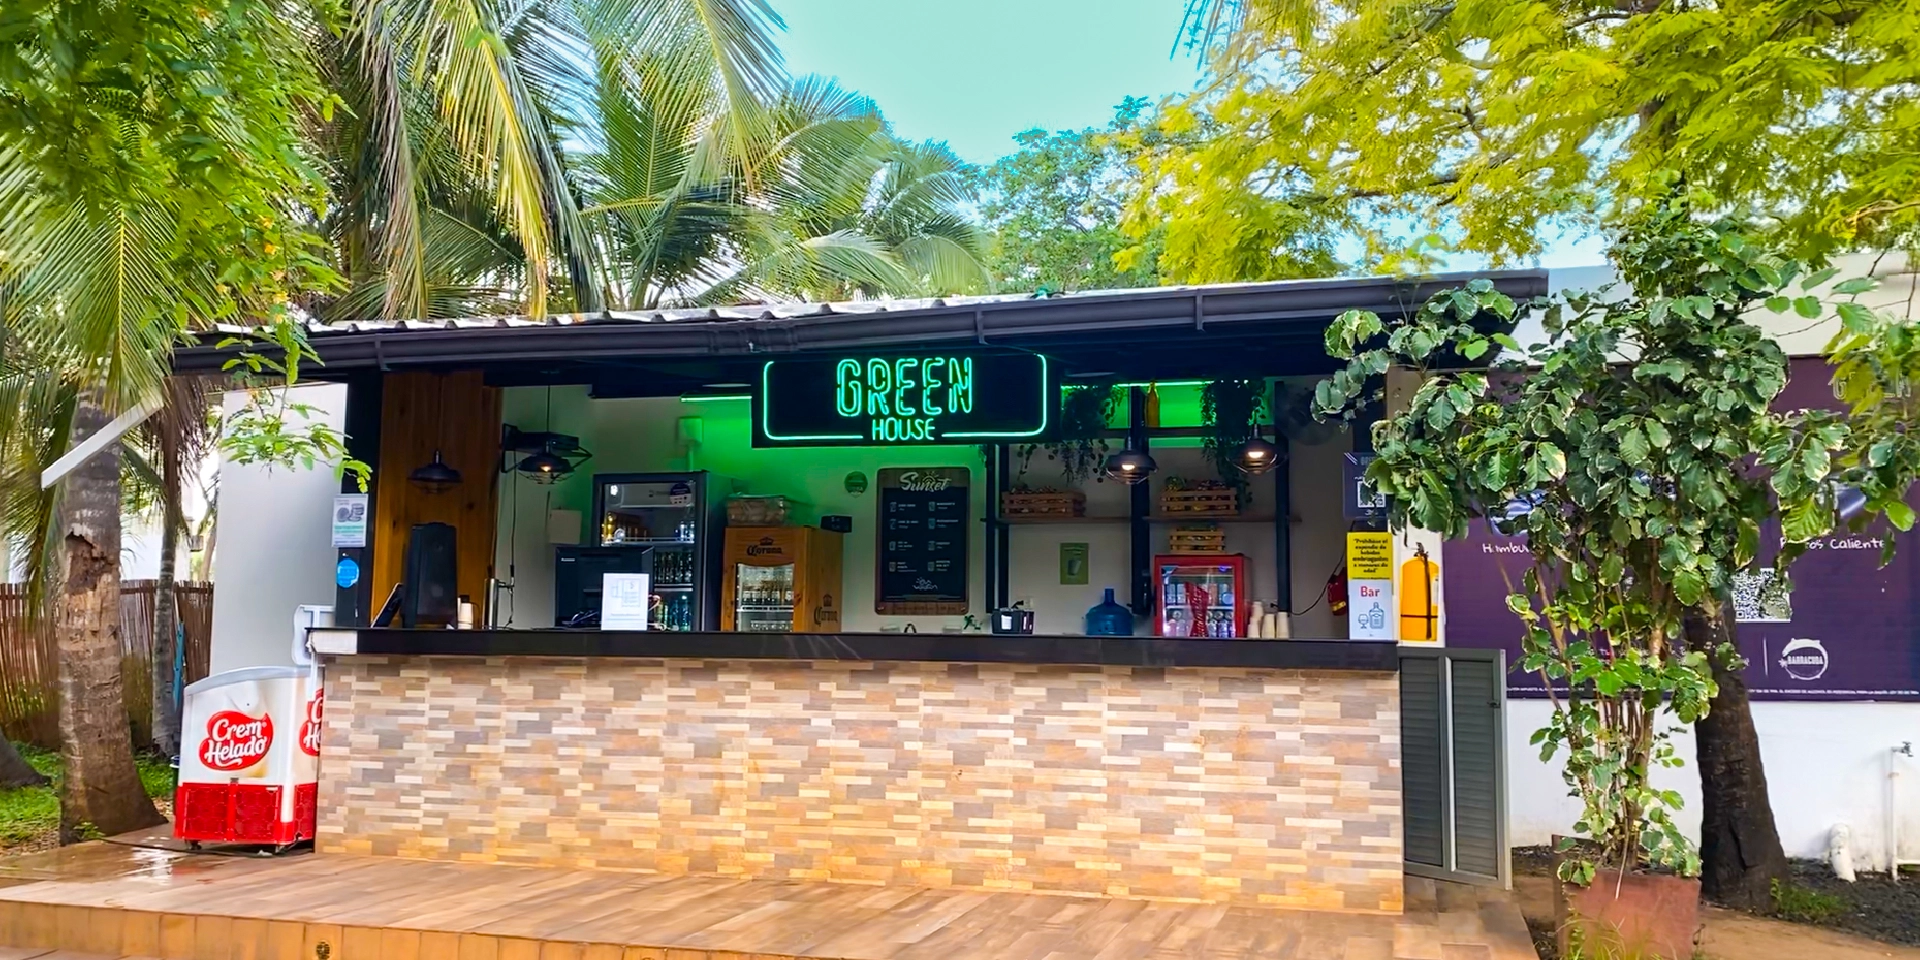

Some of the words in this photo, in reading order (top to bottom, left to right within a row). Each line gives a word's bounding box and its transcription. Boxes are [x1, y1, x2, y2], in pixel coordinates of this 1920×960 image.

[836, 357, 973, 417] GREEN
[871, 417, 936, 442] HOUSE
[899, 471, 952, 492] Sunset
[746, 545, 783, 557] Corona
[1360, 585, 1380, 597] Bar
[813, 605, 838, 627] Corona
[1787, 655, 1824, 665] BARRACUDA
[212, 718, 262, 742] Crem
[203, 735, 268, 767] Helado
